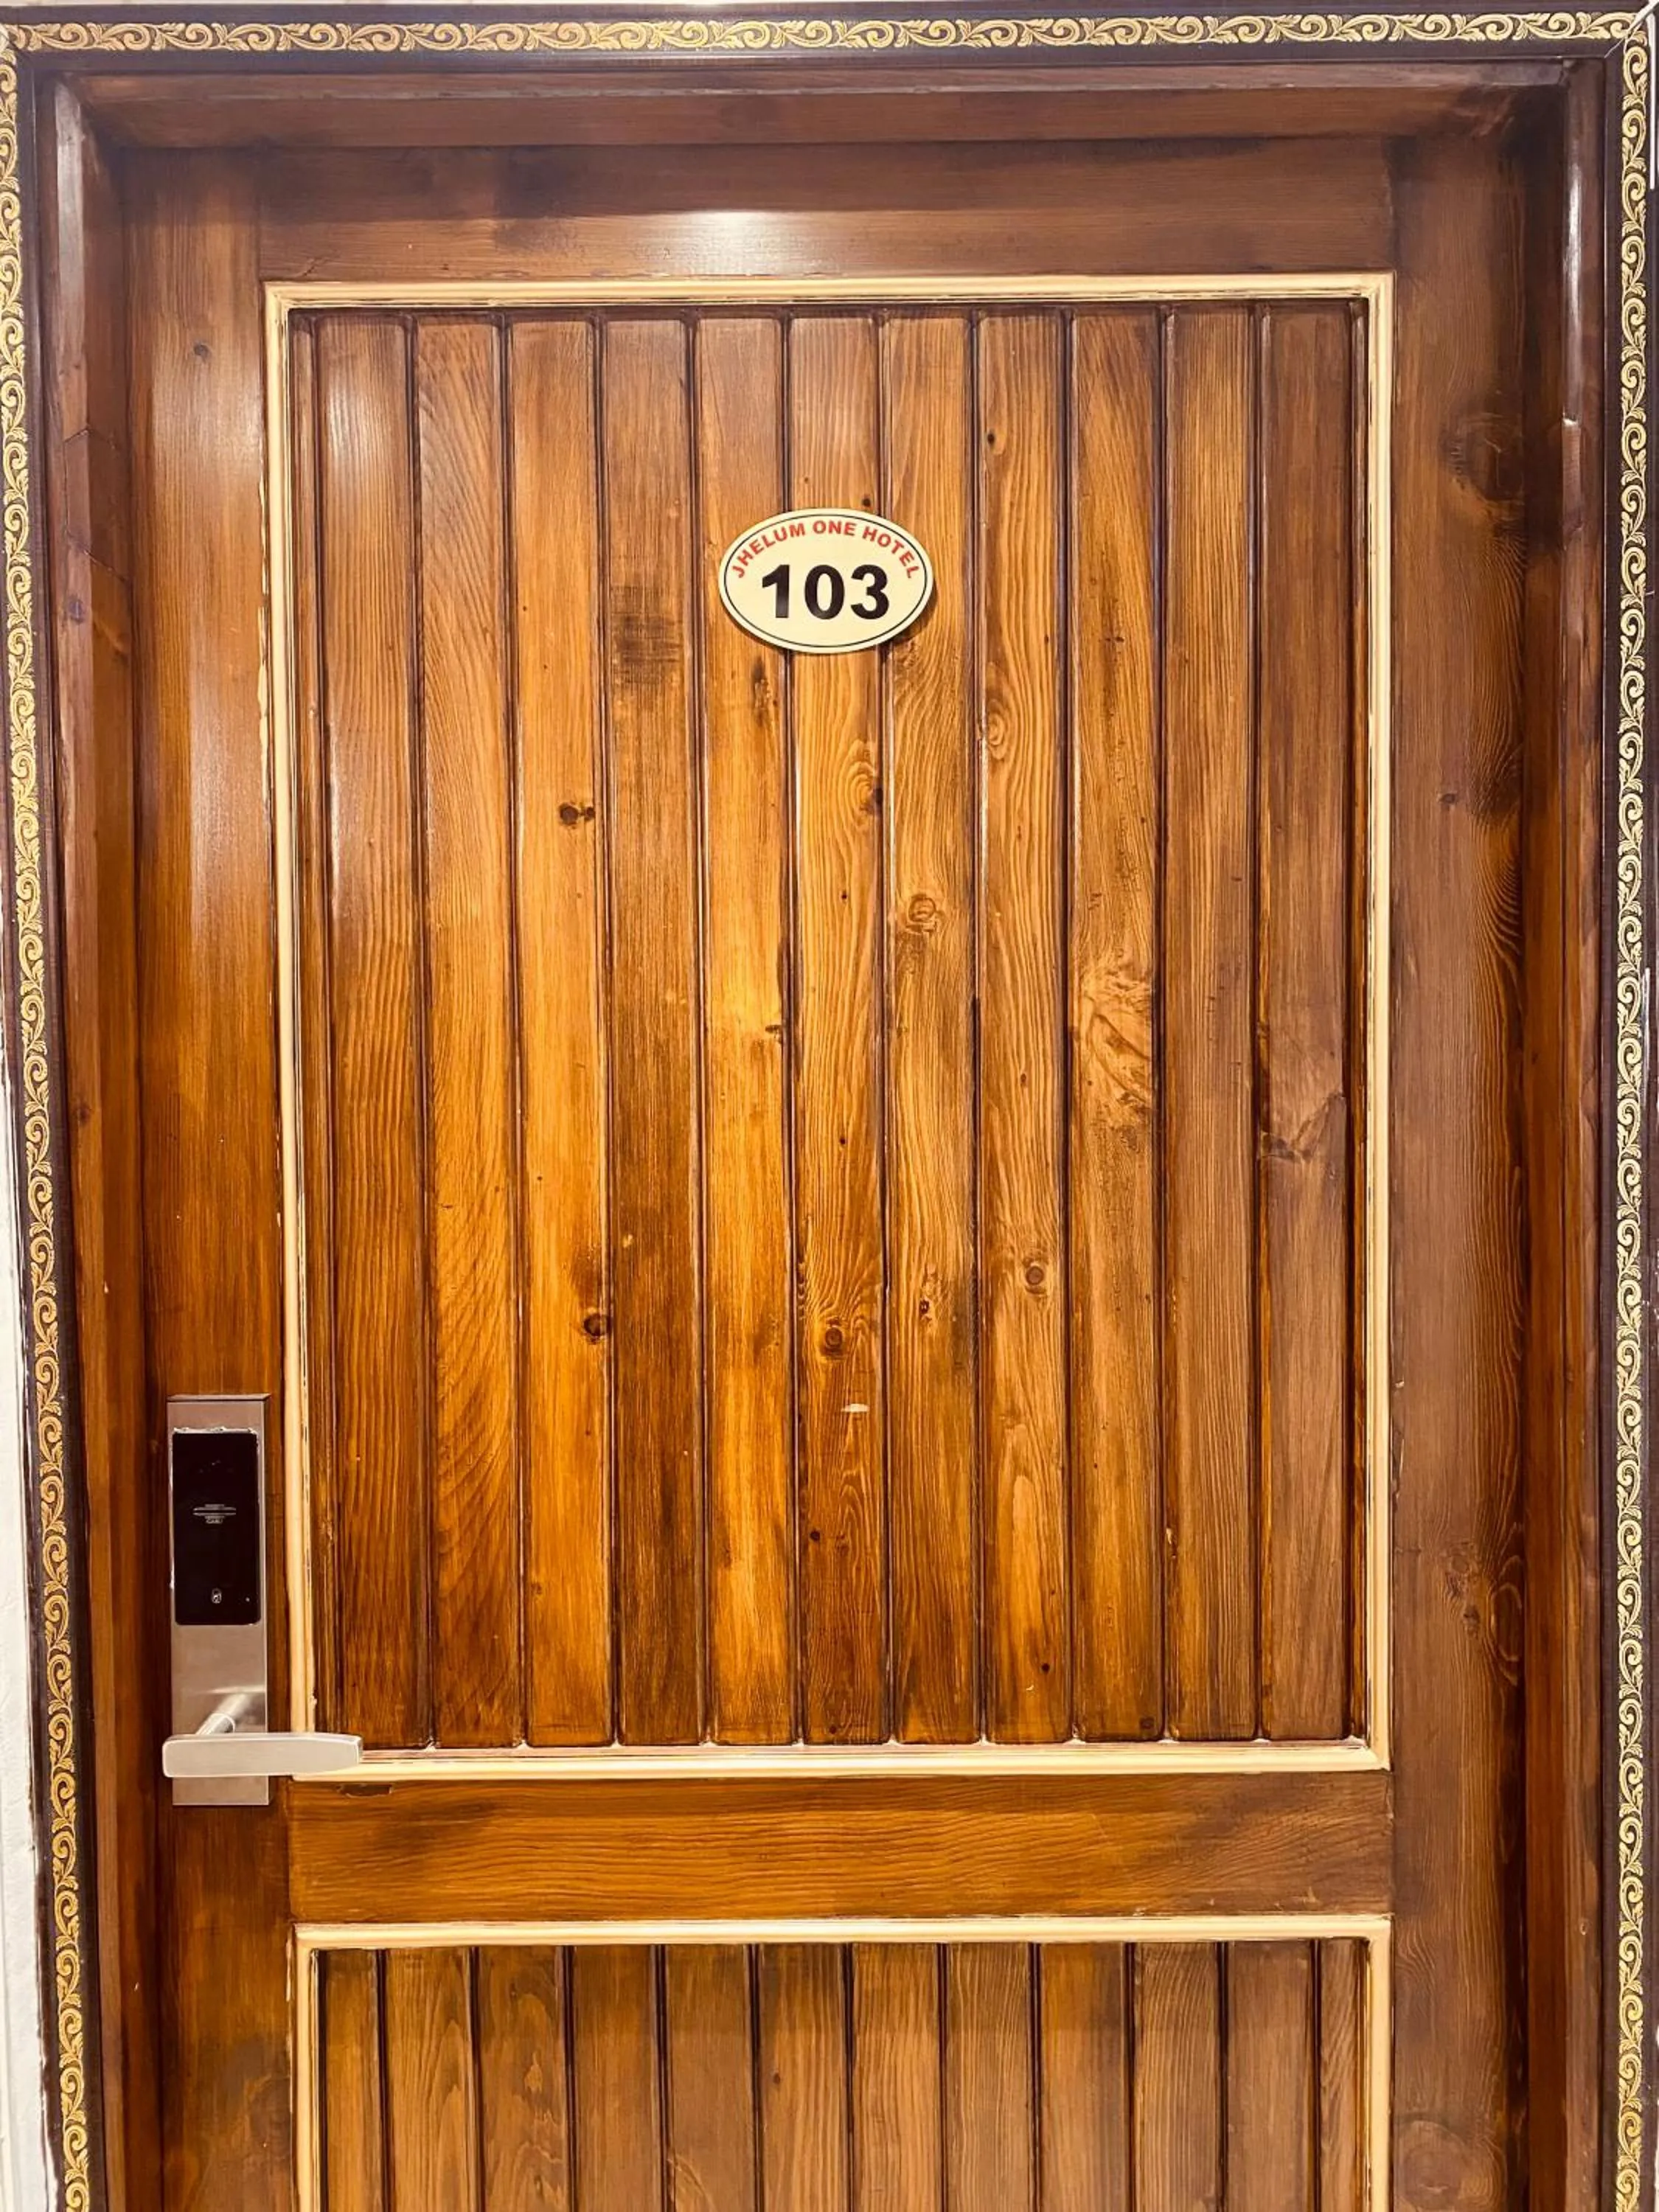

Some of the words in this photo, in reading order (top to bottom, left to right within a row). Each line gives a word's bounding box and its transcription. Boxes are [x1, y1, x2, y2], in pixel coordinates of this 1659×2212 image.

[732, 523, 806, 578] JHELUM
[813, 520, 858, 537] ONE
[862, 526, 920, 579] HOTEL
[762, 564, 890, 620] 103
